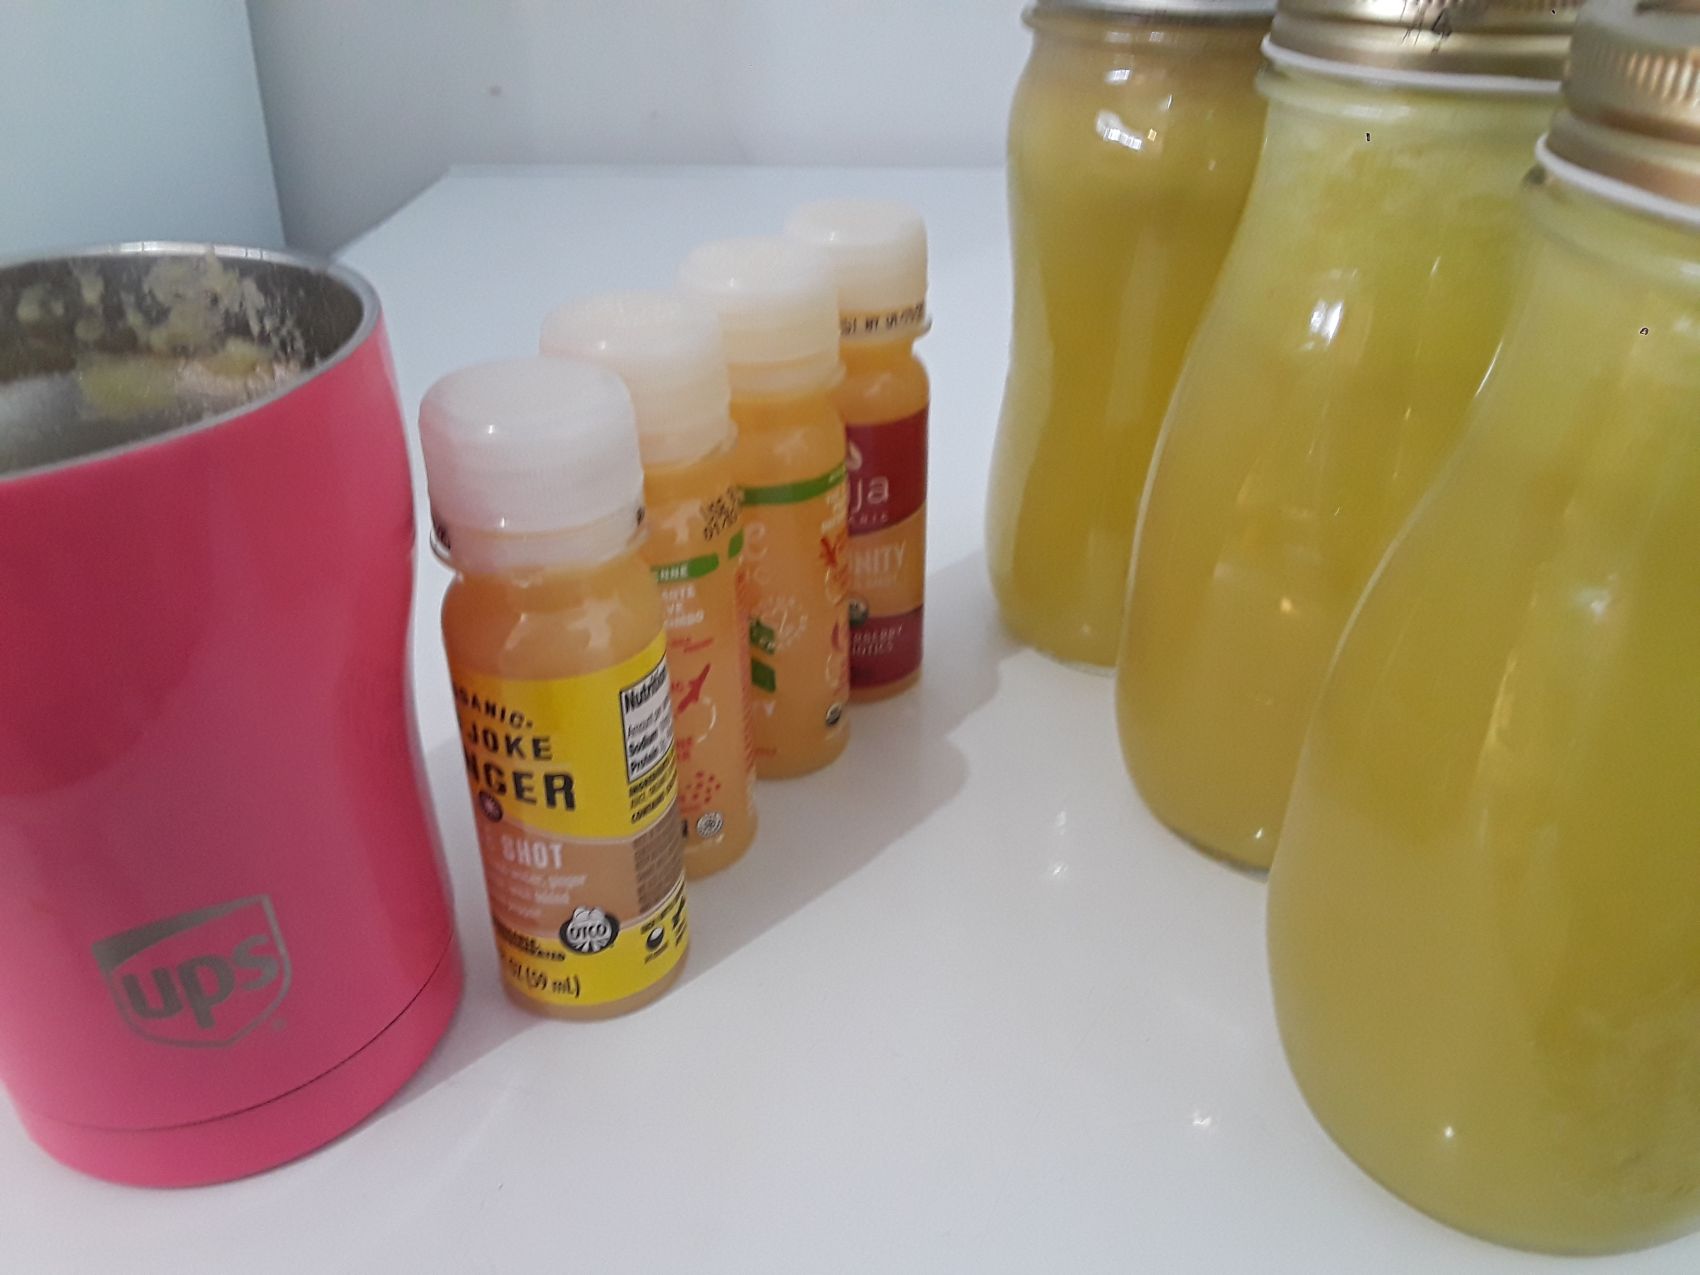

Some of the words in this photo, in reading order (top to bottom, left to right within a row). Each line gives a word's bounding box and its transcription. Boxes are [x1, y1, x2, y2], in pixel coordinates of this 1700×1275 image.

[467, 720, 554, 761] JOKE
[500, 834, 564, 871] SHOT
[121, 934, 280, 1030] ups
